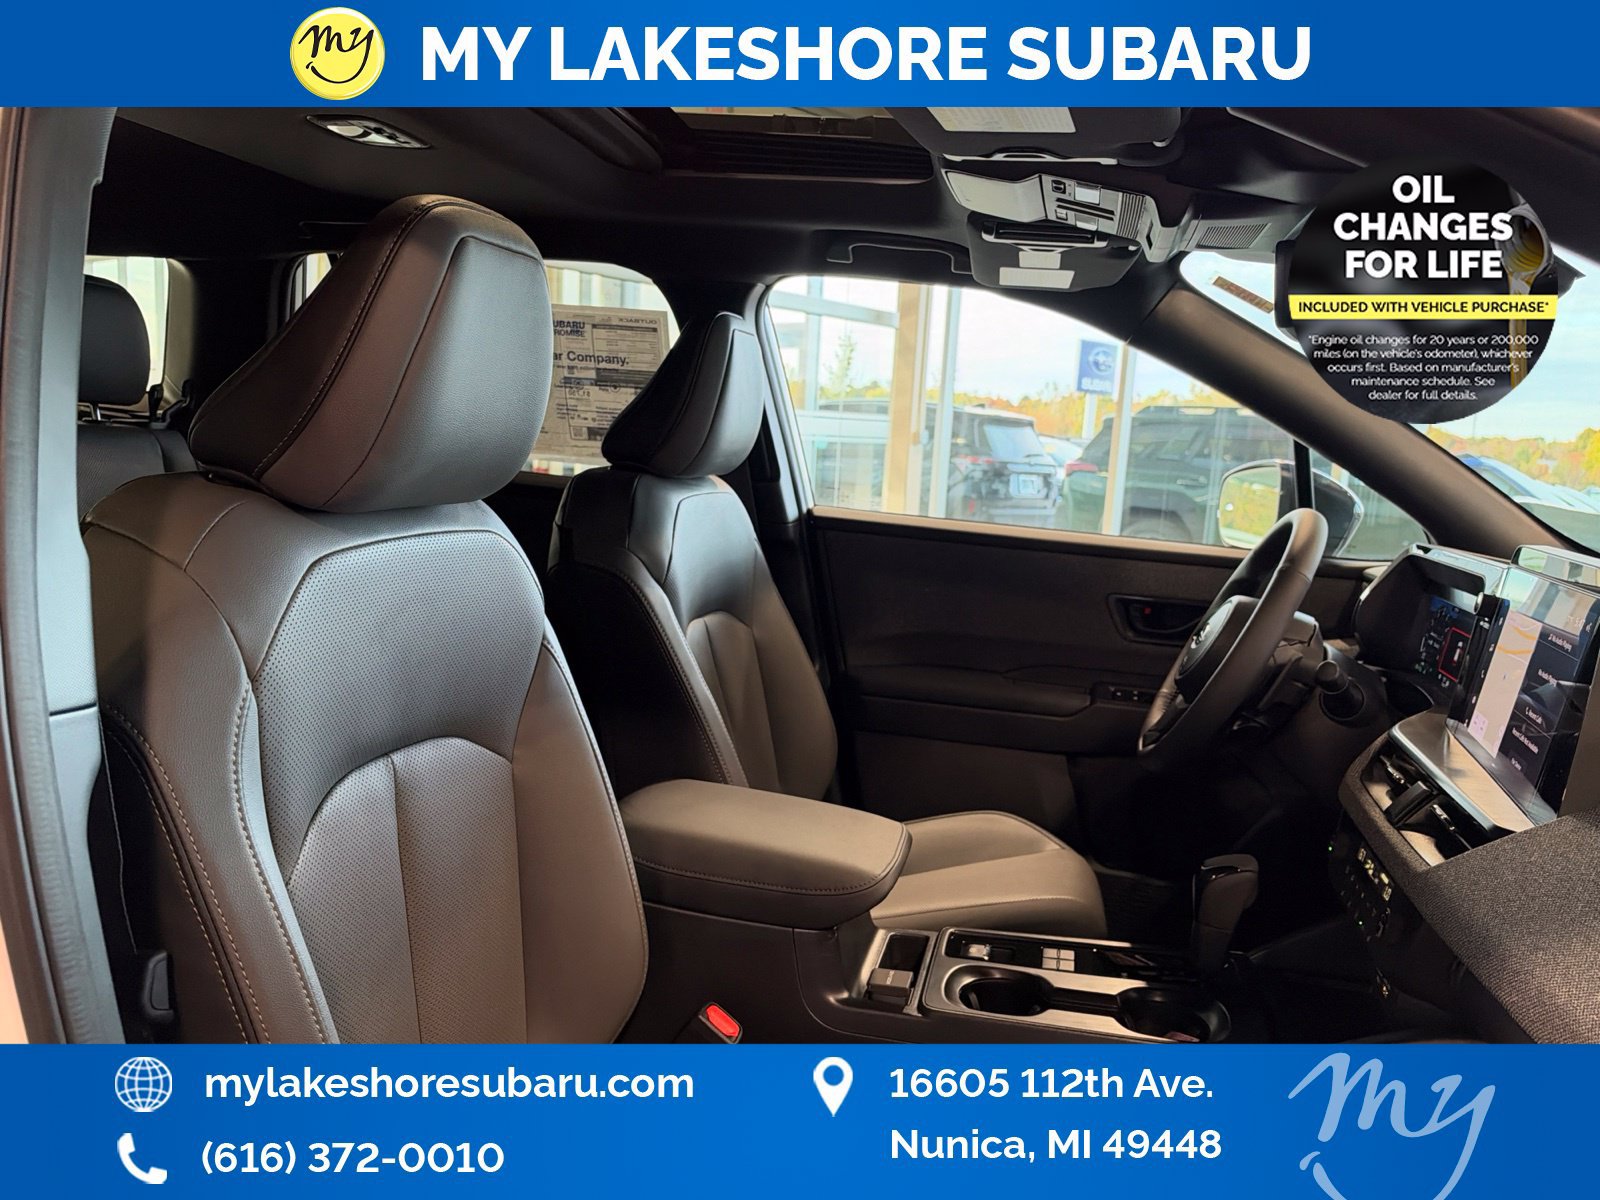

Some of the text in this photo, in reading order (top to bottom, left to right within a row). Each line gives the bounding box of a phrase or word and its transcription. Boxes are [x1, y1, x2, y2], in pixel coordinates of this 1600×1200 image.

[553, 320, 585, 329] UBARU
[553, 329, 586, 337] ROMISE
[553, 351, 629, 366] ar Company.
